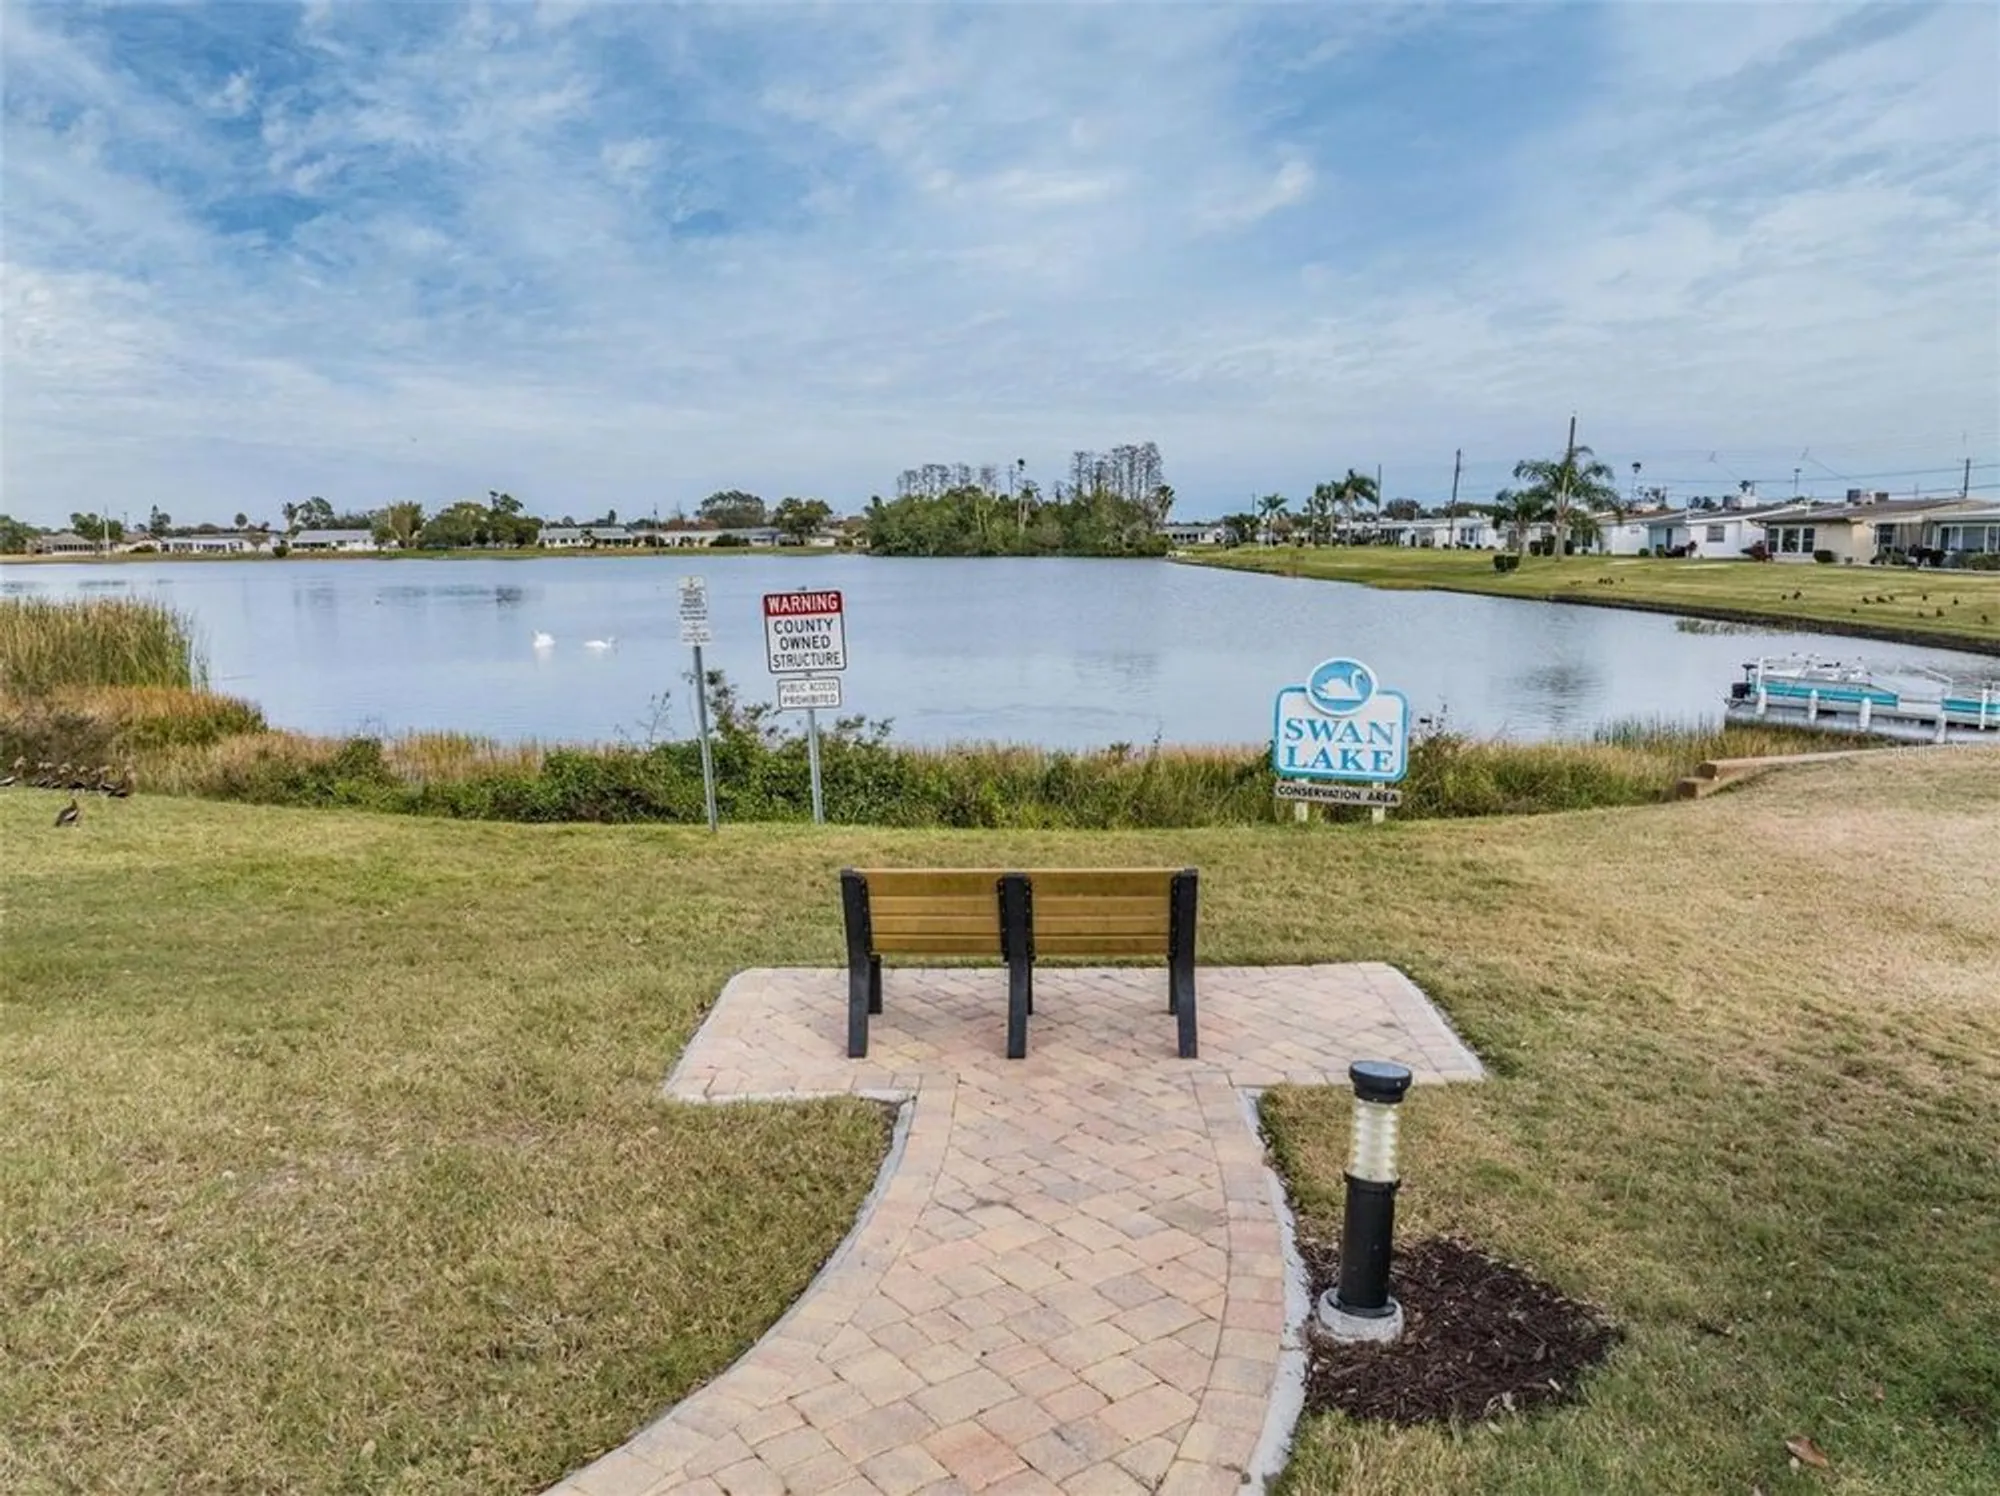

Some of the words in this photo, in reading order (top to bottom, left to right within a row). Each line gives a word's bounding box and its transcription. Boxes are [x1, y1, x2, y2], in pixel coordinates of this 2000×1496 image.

[767, 593, 839, 613] WARNING
[773, 618, 834, 635] COUNTY
[779, 634, 831, 651] OWNED
[772, 651, 841, 669] STRUCTURE
[1285, 718, 1396, 745] SWAN
[1285, 746, 1394, 772] LAKE
[1277, 786, 1361, 800] CONSERVATION
[1367, 792, 1398, 802] AREA
